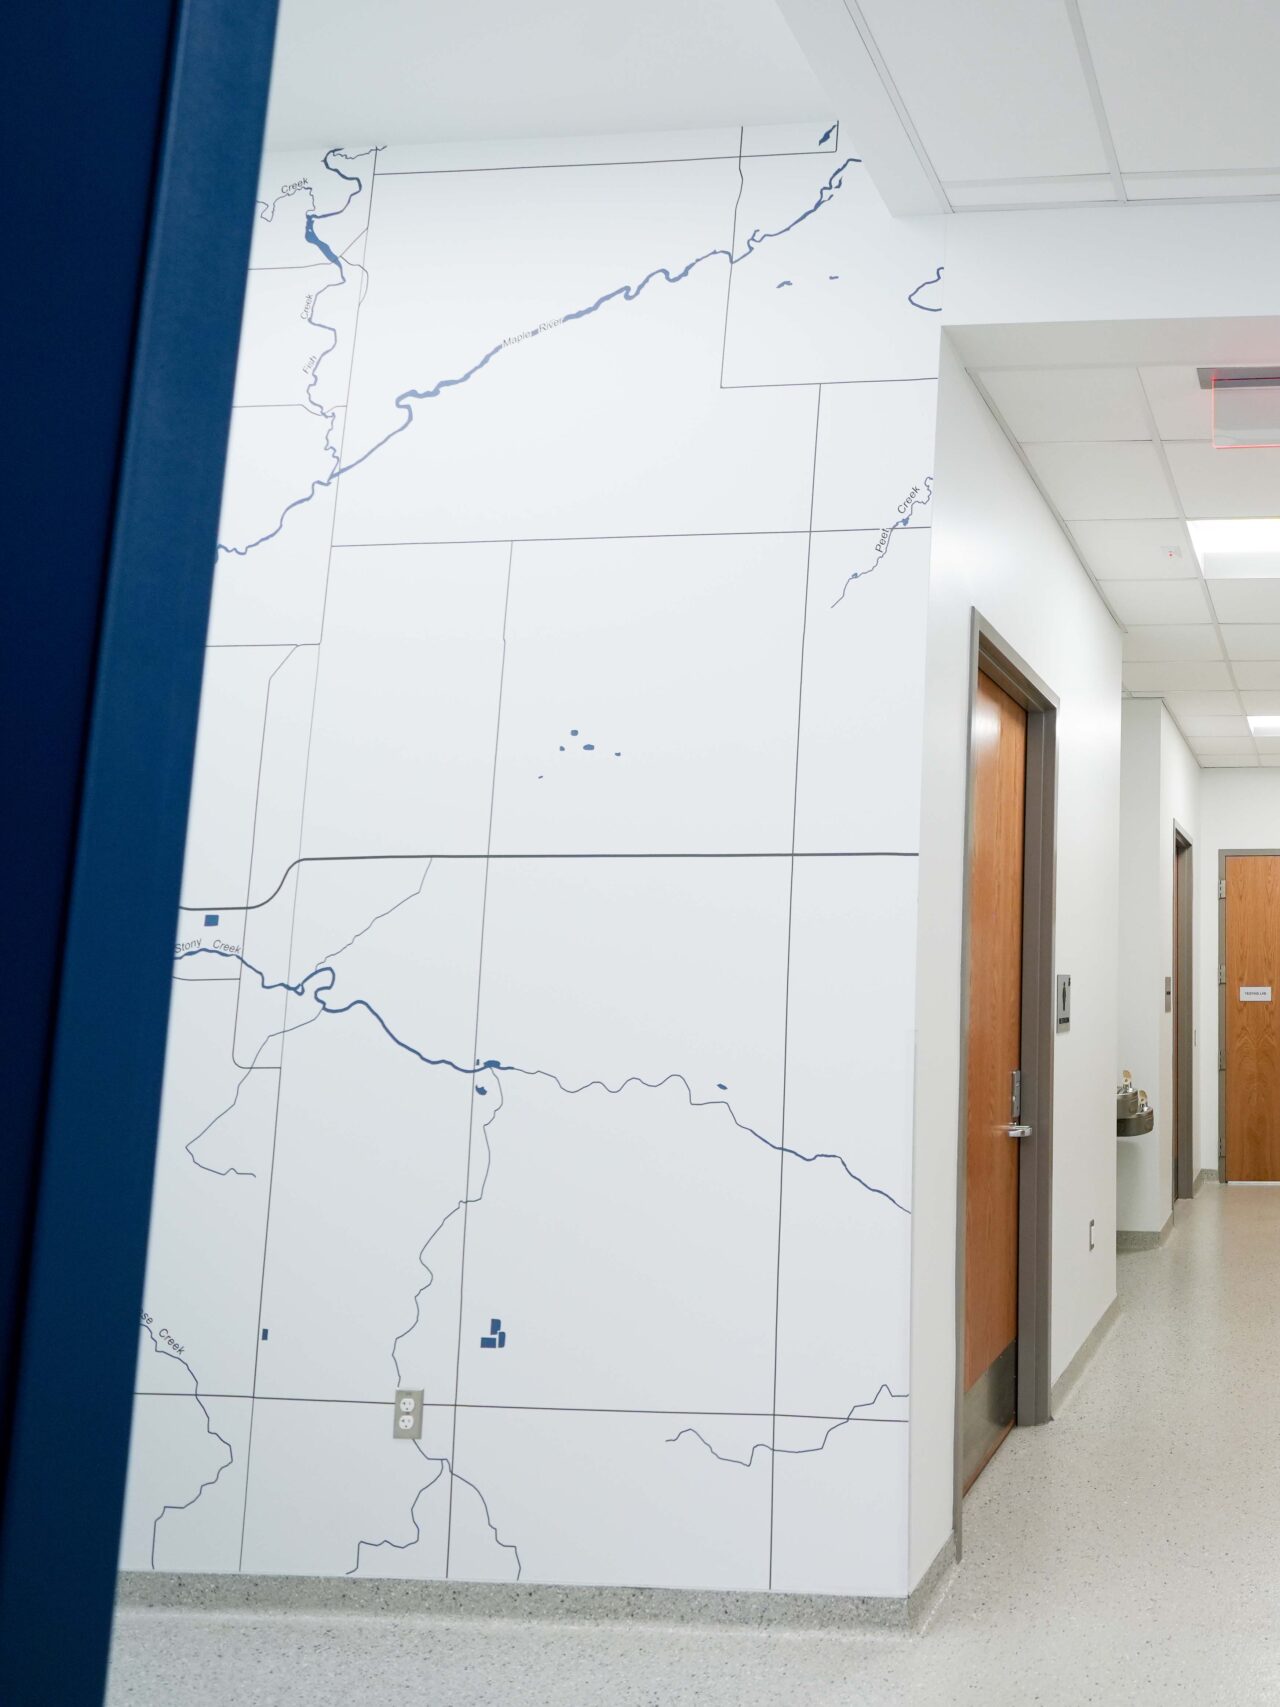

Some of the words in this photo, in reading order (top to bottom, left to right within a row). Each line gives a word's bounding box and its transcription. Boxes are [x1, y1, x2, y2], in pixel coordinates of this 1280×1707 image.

[280, 177, 309, 194] Creek
[299, 293, 314, 320] Creek
[502, 330, 531, 348] Maple
[539, 317, 562, 333] River
[302, 354, 317, 375] Fish
[897, 485, 921, 514] Creek
[175, 938, 202, 954] Stony
[212, 939, 242, 954] Creek
[158, 1327, 185, 1355] Creek
